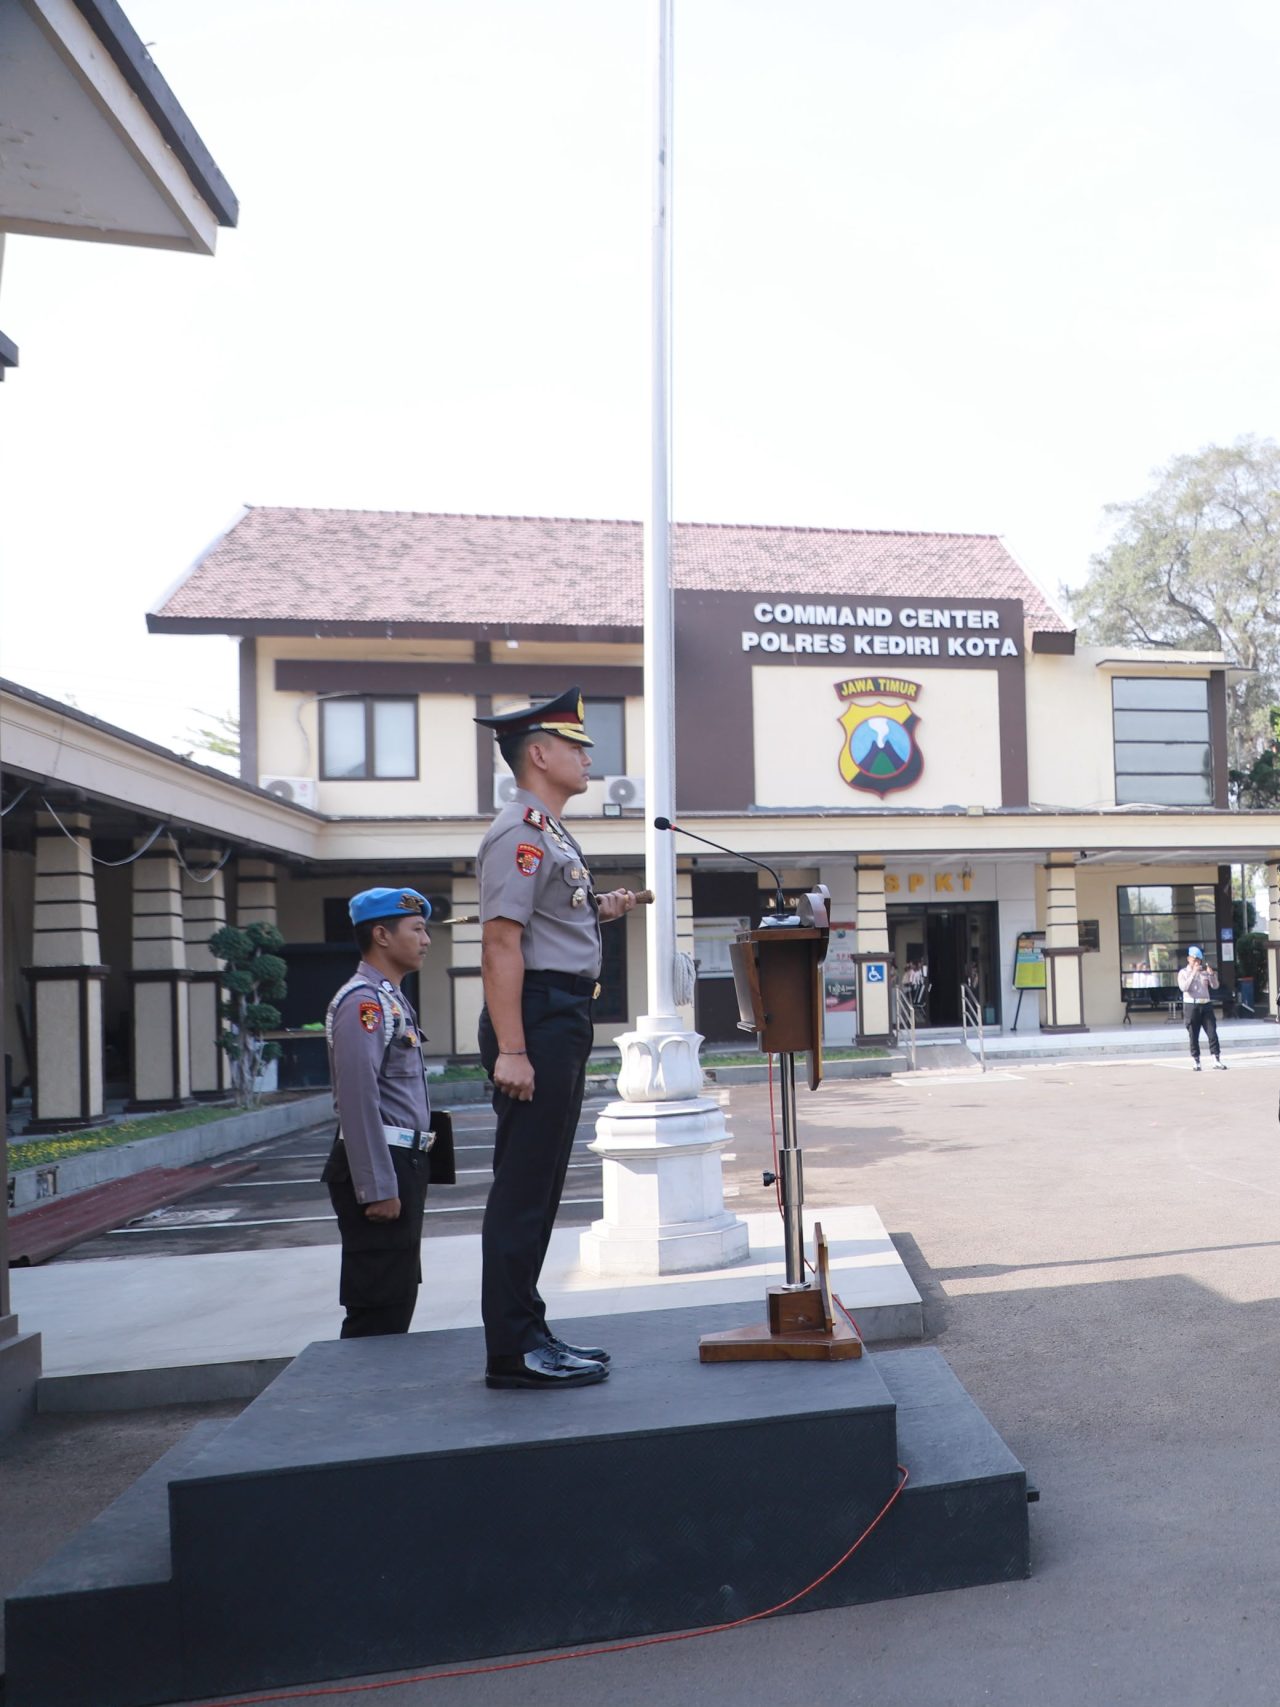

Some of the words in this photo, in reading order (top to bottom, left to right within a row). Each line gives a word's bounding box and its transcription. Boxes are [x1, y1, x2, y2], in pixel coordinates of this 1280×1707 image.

[754, 603, 893, 627] COMMAND
[899, 608, 1000, 629] CENTER
[742, 632, 847, 654] POLRES
[854, 635, 940, 656] KEDIRI
[948, 637, 1018, 657] KOTA
[841, 679, 875, 697] JAWA
[878, 678, 917, 697] TIMUR
[884, 873, 976, 893] SPKT
